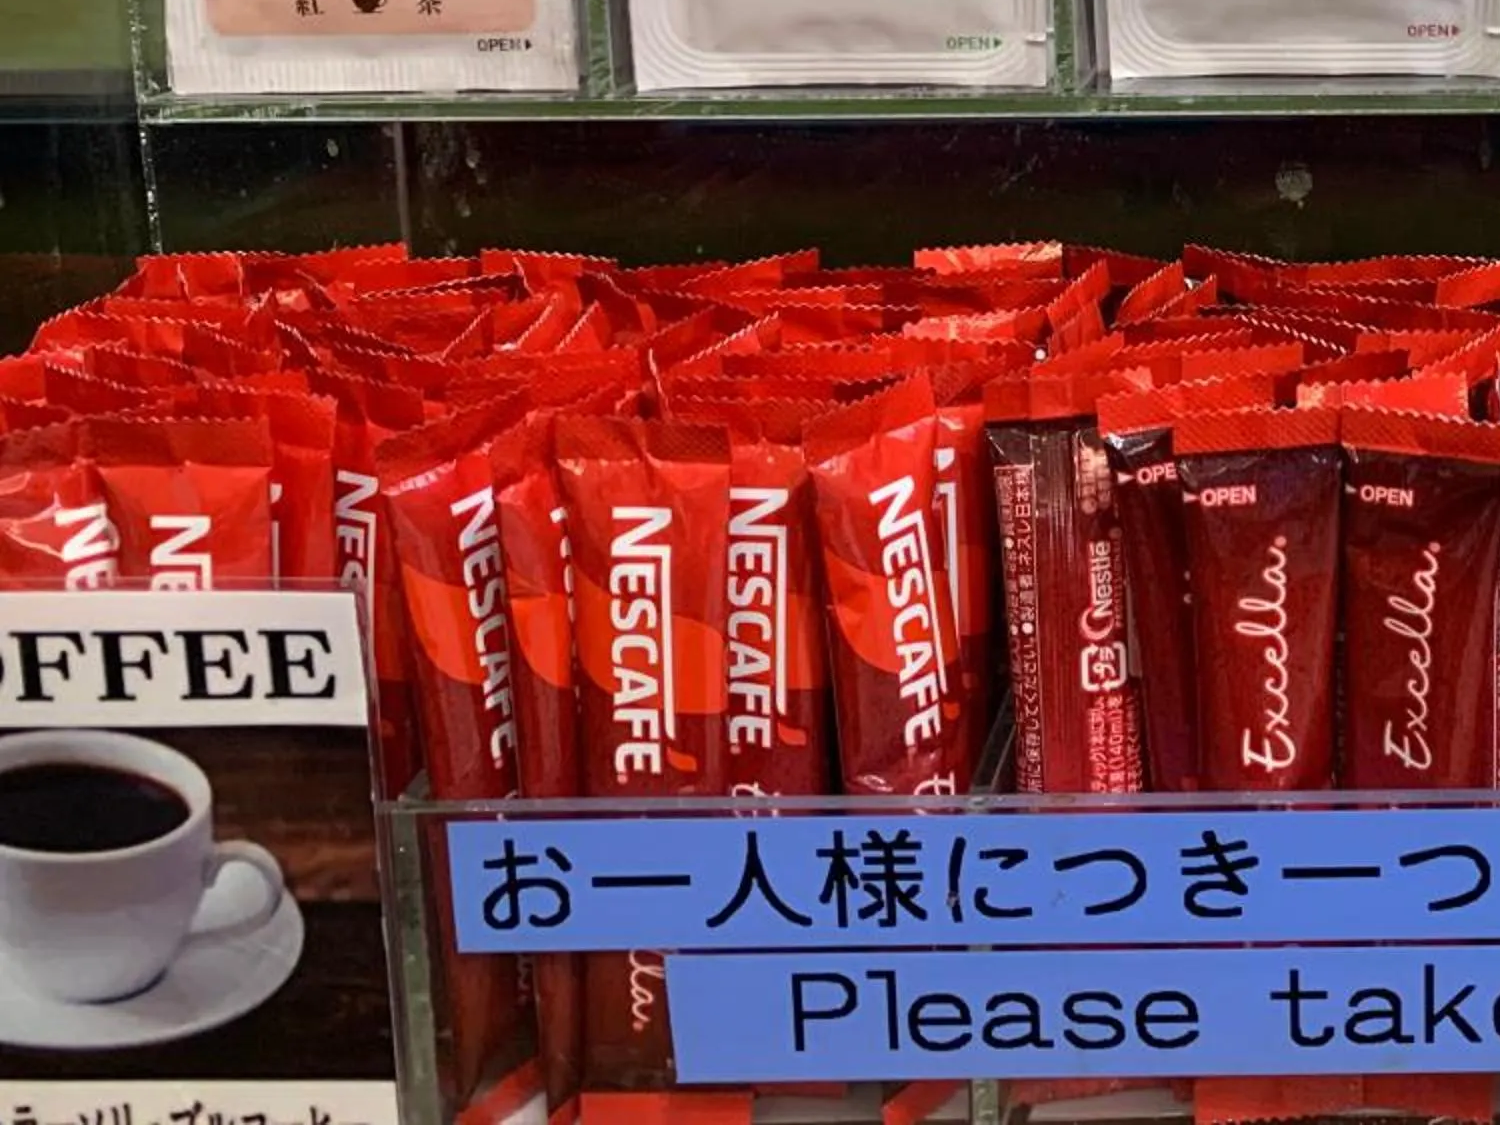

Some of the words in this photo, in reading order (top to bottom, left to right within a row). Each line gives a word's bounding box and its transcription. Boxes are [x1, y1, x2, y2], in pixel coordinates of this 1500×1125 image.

[1407, 24, 1450, 38] OPEN
[477, 38, 522, 53] OPEN
[945, 36, 991, 51] OPEN
[1136, 461, 1178, 485] OPE
[1200, 484, 1256, 507] OPEN
[1360, 484, 1414, 507] OPEN
[1088, 540, 1113, 618] Nestlé
[1235, 542, 1296, 772] Excella
[1383, 548, 1440, 771] Excella
[790, 970, 1198, 1053] Please
